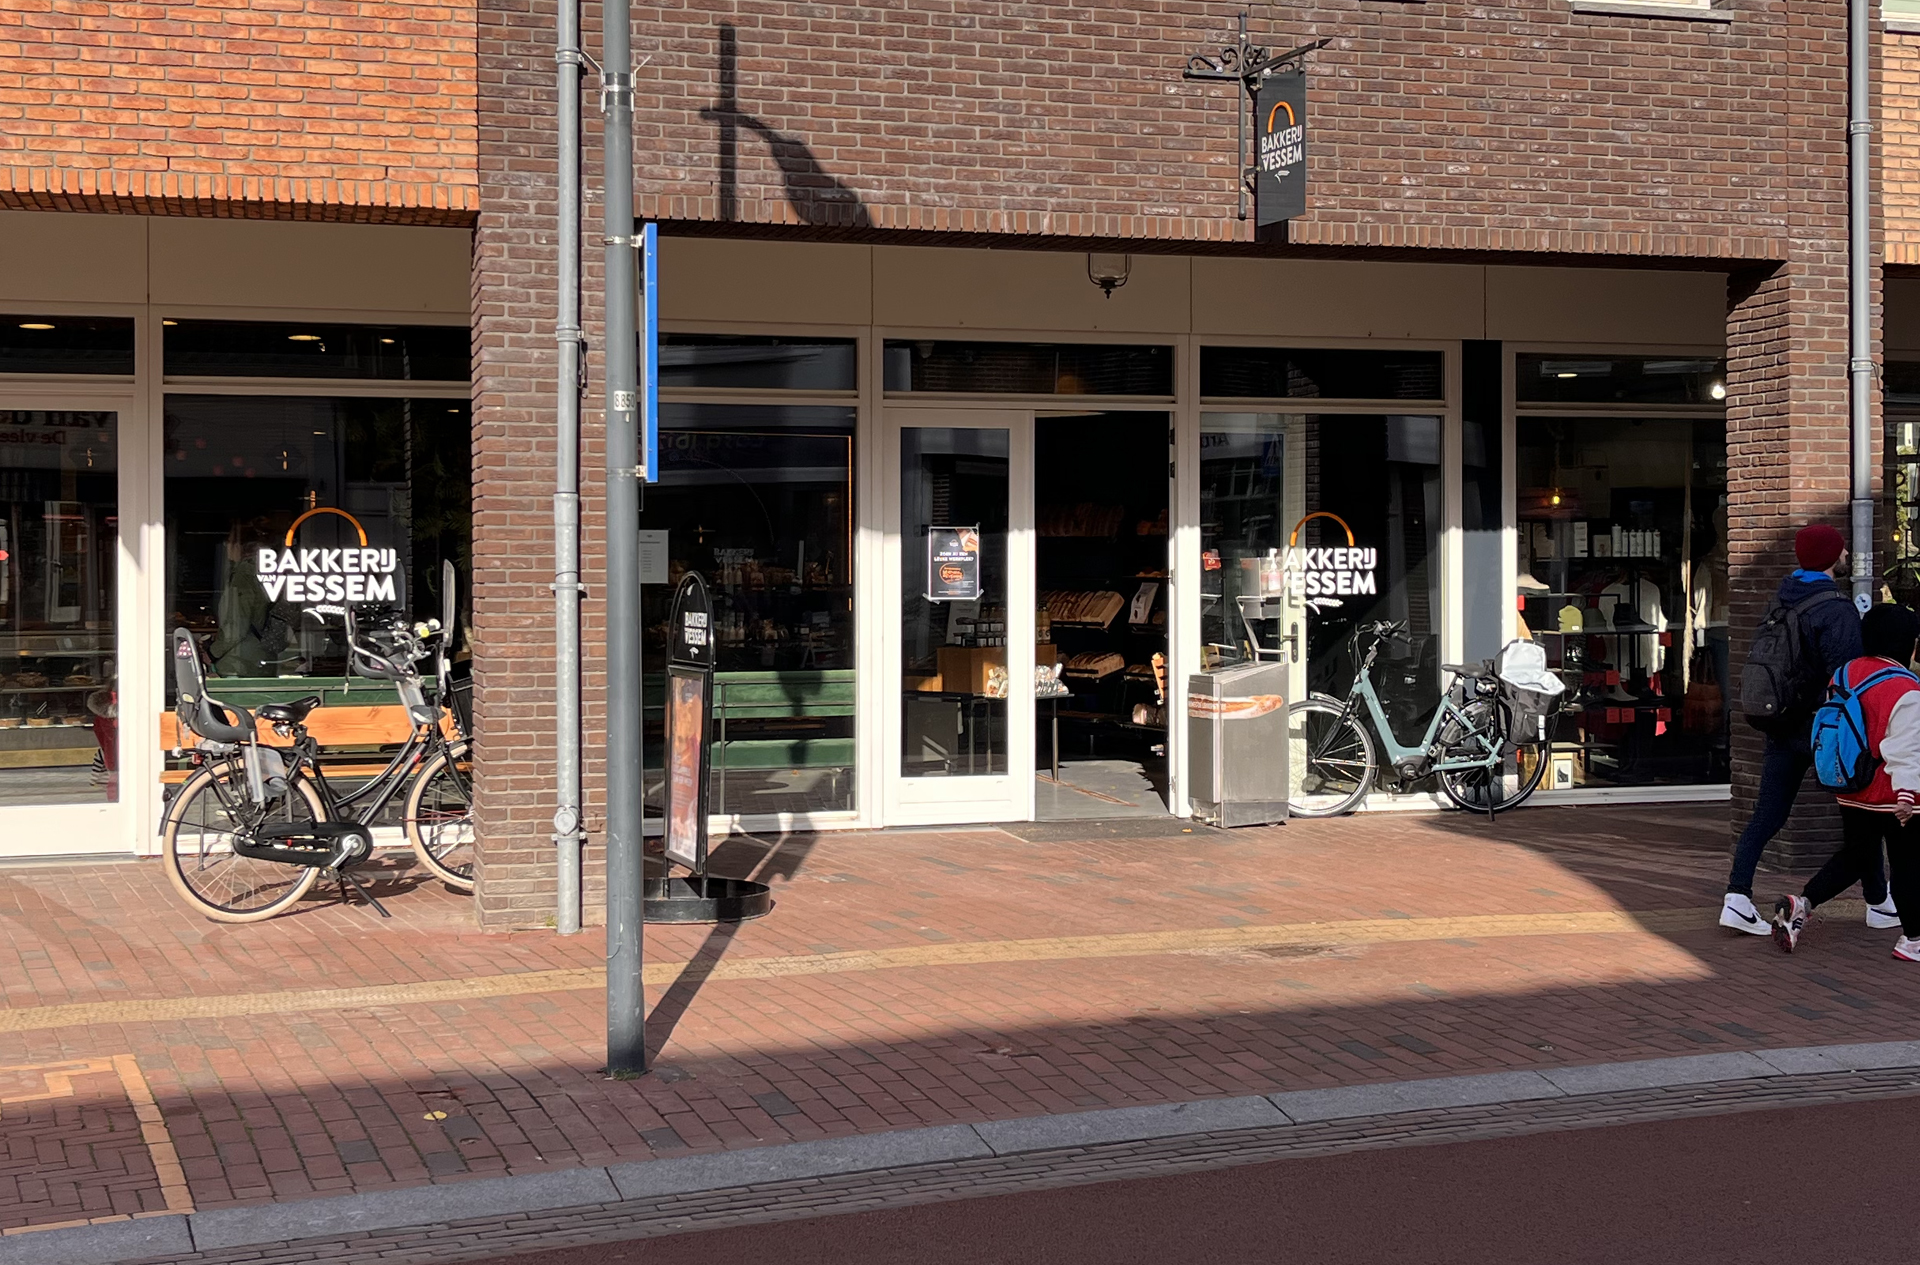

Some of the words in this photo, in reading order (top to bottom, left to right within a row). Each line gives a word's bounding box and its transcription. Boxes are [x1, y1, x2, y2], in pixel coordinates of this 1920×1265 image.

[1261, 125, 1303, 153] BAKKERIJ
[1261, 144, 1303, 172] VESSEM
[258, 548, 397, 573] BAKKERIJ
[1282, 547, 1377, 570] AKKERIJ
[261, 574, 397, 602] VESSEM
